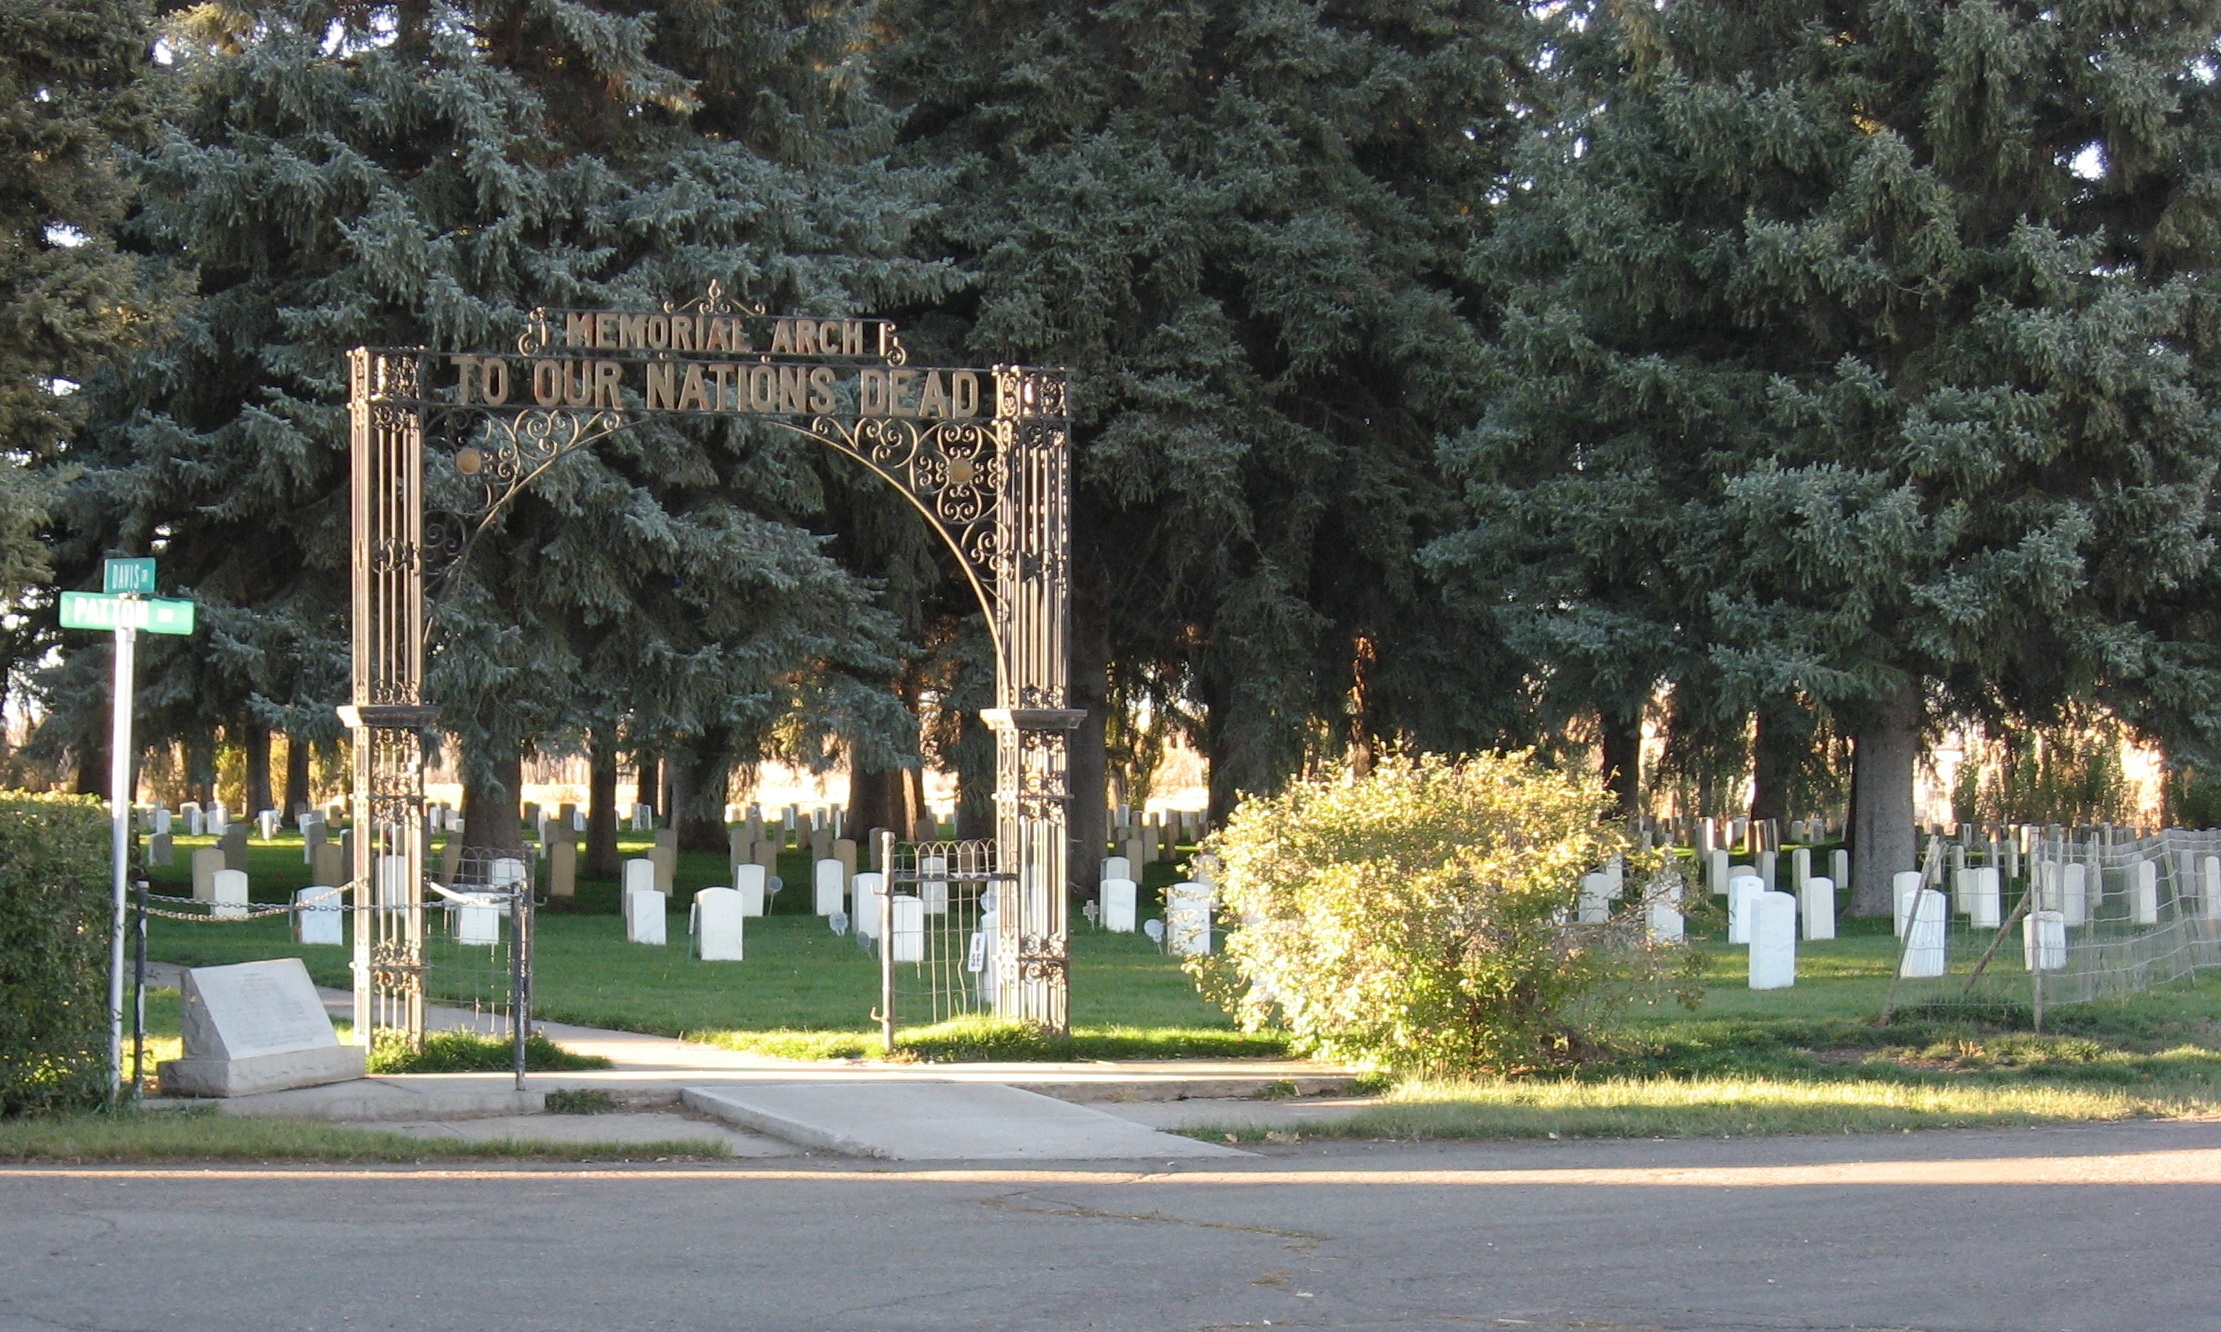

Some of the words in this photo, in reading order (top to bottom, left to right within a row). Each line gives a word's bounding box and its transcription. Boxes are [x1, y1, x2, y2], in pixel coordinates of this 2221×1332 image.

[566, 311, 752, 352] MEMORIAL
[771, 318, 863, 355] ARCH
[450, 354, 509, 406] TO
[534, 358, 624, 411] OUR
[646, 362, 836, 414] NATIONS
[860, 369, 979, 419] DEAD
[112, 564, 140, 589] DAVIS
[73, 597, 149, 626] PATTON
